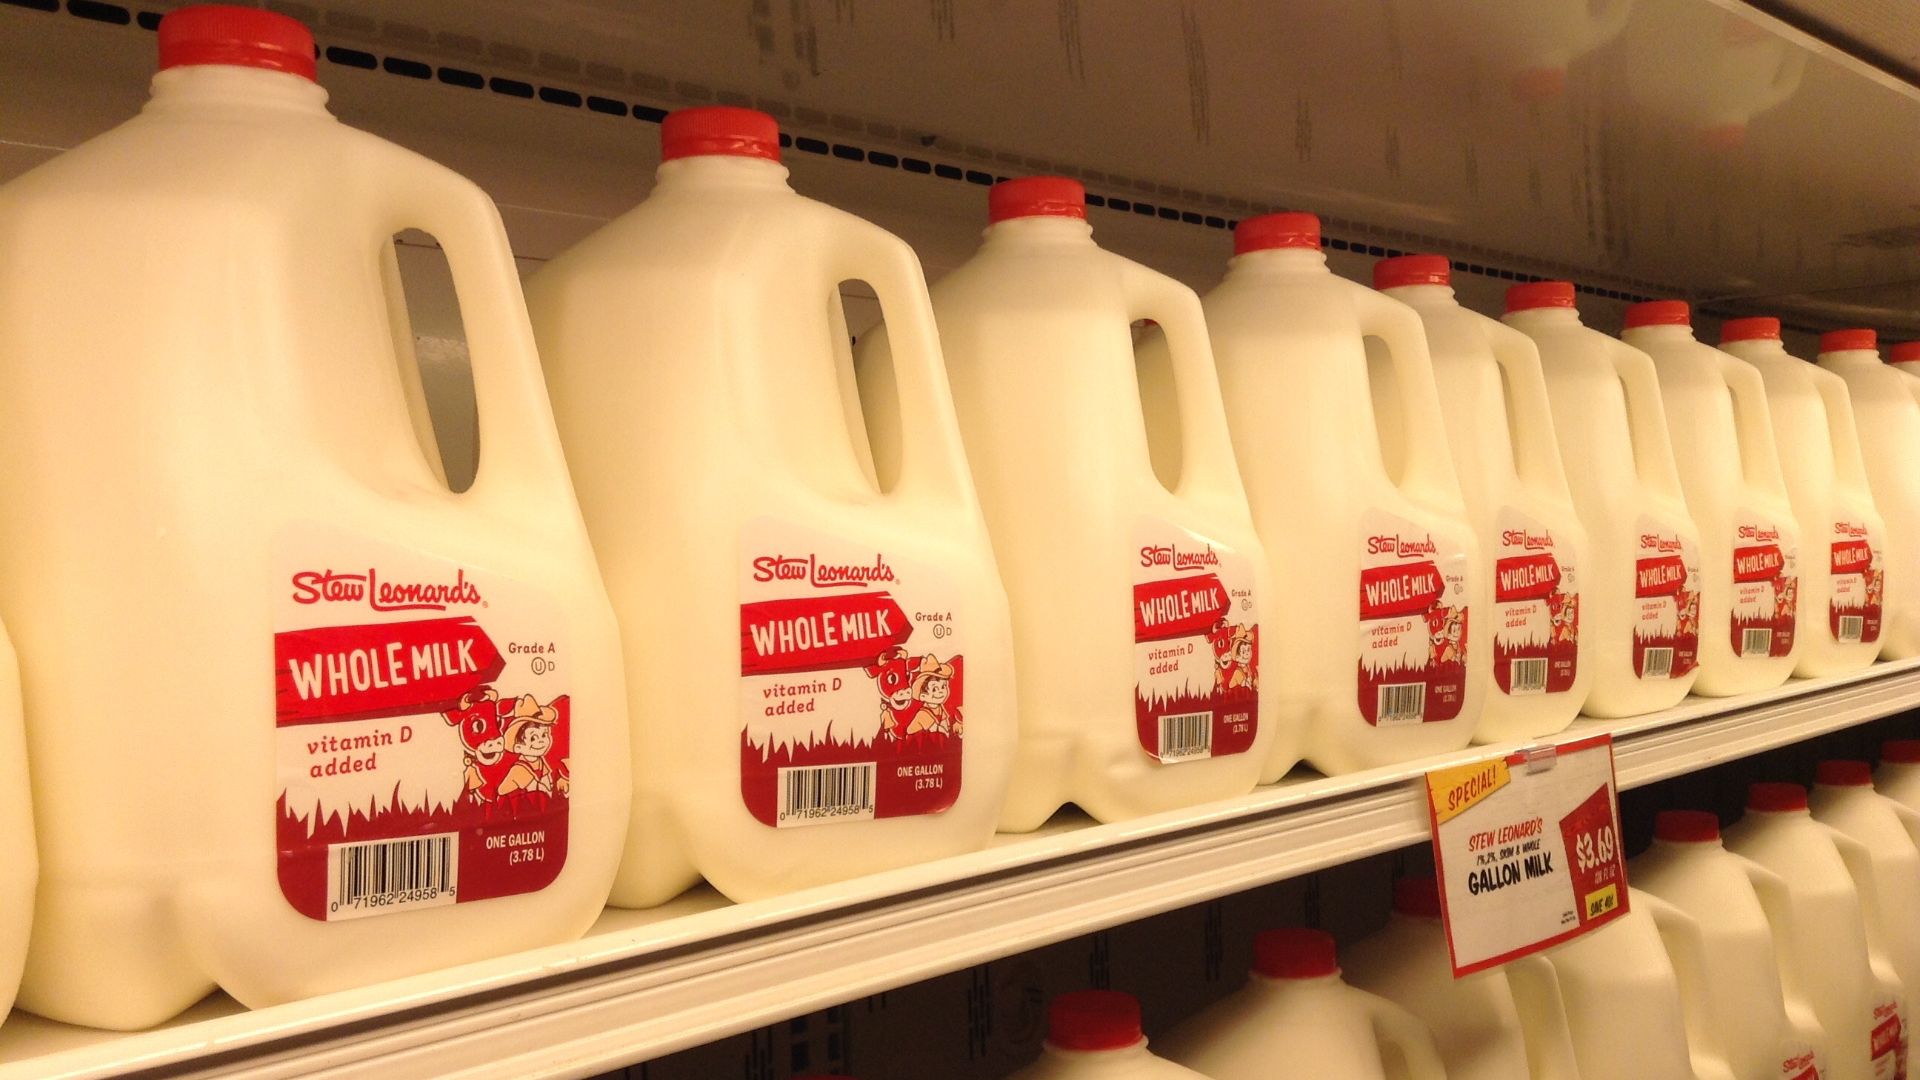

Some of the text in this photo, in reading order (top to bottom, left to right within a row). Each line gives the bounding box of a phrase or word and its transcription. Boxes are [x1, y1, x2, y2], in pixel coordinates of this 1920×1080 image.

[1140, 543, 1219, 571] Stew Leonard's
[1368, 533, 1436, 558] Stew Leonard's
[753, 553, 895, 588] Stew Leonard's
[1737, 552, 1779, 574] WHOLE MILK
[1500, 563, 1555, 592] WHOLE MILK
[1639, 564, 1682, 588] WHOLE MILK
[291, 568, 481, 611] Stew Leonard's
[1365, 575, 1410, 607] WHOLE
[1411, 573, 1436, 596] MILK
[915, 611, 953, 622] Grade A
[1140, 589, 1191, 627] WHOLE
[1191, 587, 1220, 613] MILK
[750, 609, 892, 656] WHOLE MILK
[1371, 621, 1412, 637] vitamin D
[508, 641, 556, 654] Grade A
[1148, 642, 1194, 661] vitamin D
[1372, 636, 1398, 649] added
[288, 638, 478, 701] WHOLE MILK
[1149, 660, 1179, 675] added
[763, 677, 842, 699] vitamin D
[765, 698, 815, 717] added
[307, 725, 413, 755] vitamin D
[310, 753, 377, 778] added
[897, 764, 943, 778] ONE GALLON
[915, 778, 936, 791] (3.78
[1448, 765, 1497, 812] SPECIAL!
[779, 804, 874, 821] 0 71962 24958 5
[486, 830, 545, 850] ONE GALLON
[1468, 816, 1543, 852] STEW LEONARD'S
[509, 847, 545, 866] (3.78 L)
[1500, 846, 1515, 860] SKIM
[1522, 838, 1541, 854] WHOLE
[1576, 826, 1614, 874] $3.69
[1468, 850, 1553, 896] GALLON MILK
[331, 886, 456, 912] 0 71962 24958 5
[1590, 898, 1604, 917] SAVE
